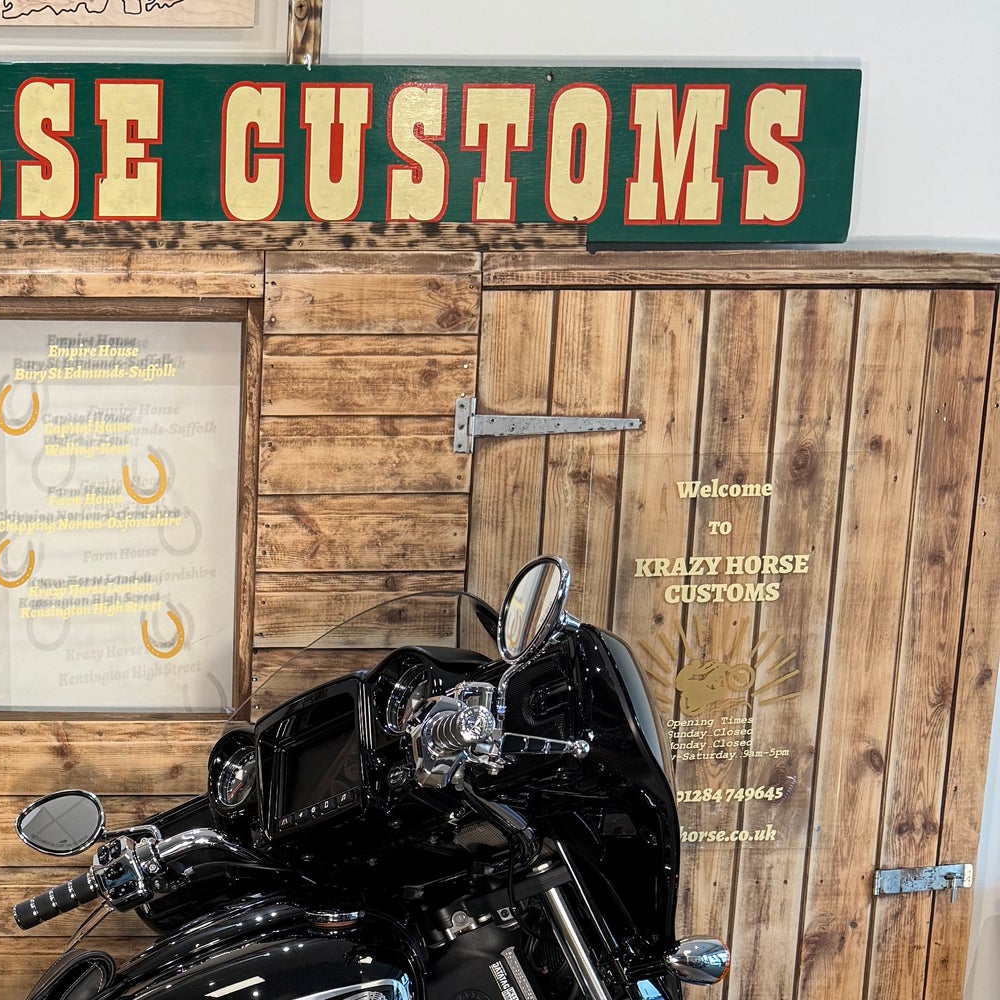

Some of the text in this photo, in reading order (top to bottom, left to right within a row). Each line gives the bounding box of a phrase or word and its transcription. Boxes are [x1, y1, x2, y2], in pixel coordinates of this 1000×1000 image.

[221, 80, 807, 226] CUSTOMS
[48, 344, 139, 360] Empire House
[13, 364, 176, 384] Bury St Edmunds-Suffolk
[87, 421, 134, 434] House
[676, 478, 773, 499] Welcome
[49, 493, 124, 506] Farm House
[58, 514, 182, 533] Norton-Oxfordshire
[708, 521, 732, 535] TO
[634, 554, 810, 578] KRAZY HORSE
[28, 580, 153, 600] Krazy Horse London
[664, 583, 781, 604] CUSTOMS
[19, 601, 163, 620] Kensington High Street
[667, 716, 754, 729] Opening Times
[725, 786, 784, 802] 749645
[680, 824, 777, 843] horse.co.uk
